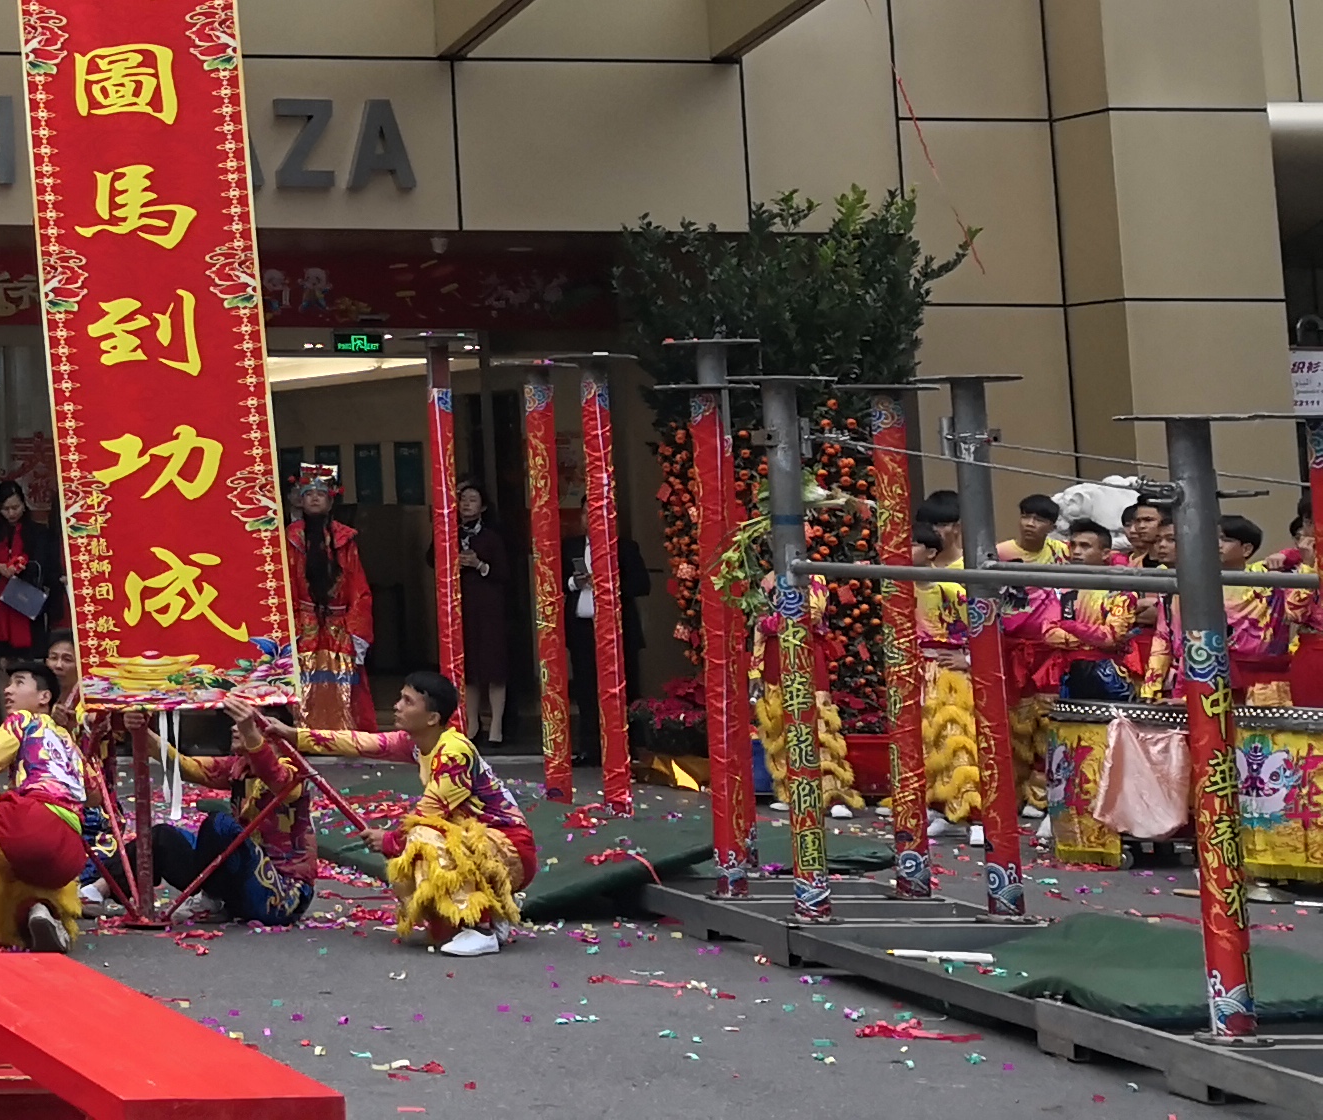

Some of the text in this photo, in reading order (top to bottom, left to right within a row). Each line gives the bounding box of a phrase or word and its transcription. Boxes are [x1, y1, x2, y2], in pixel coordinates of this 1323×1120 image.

[780, 619, 828, 871] 中華龍獅團
